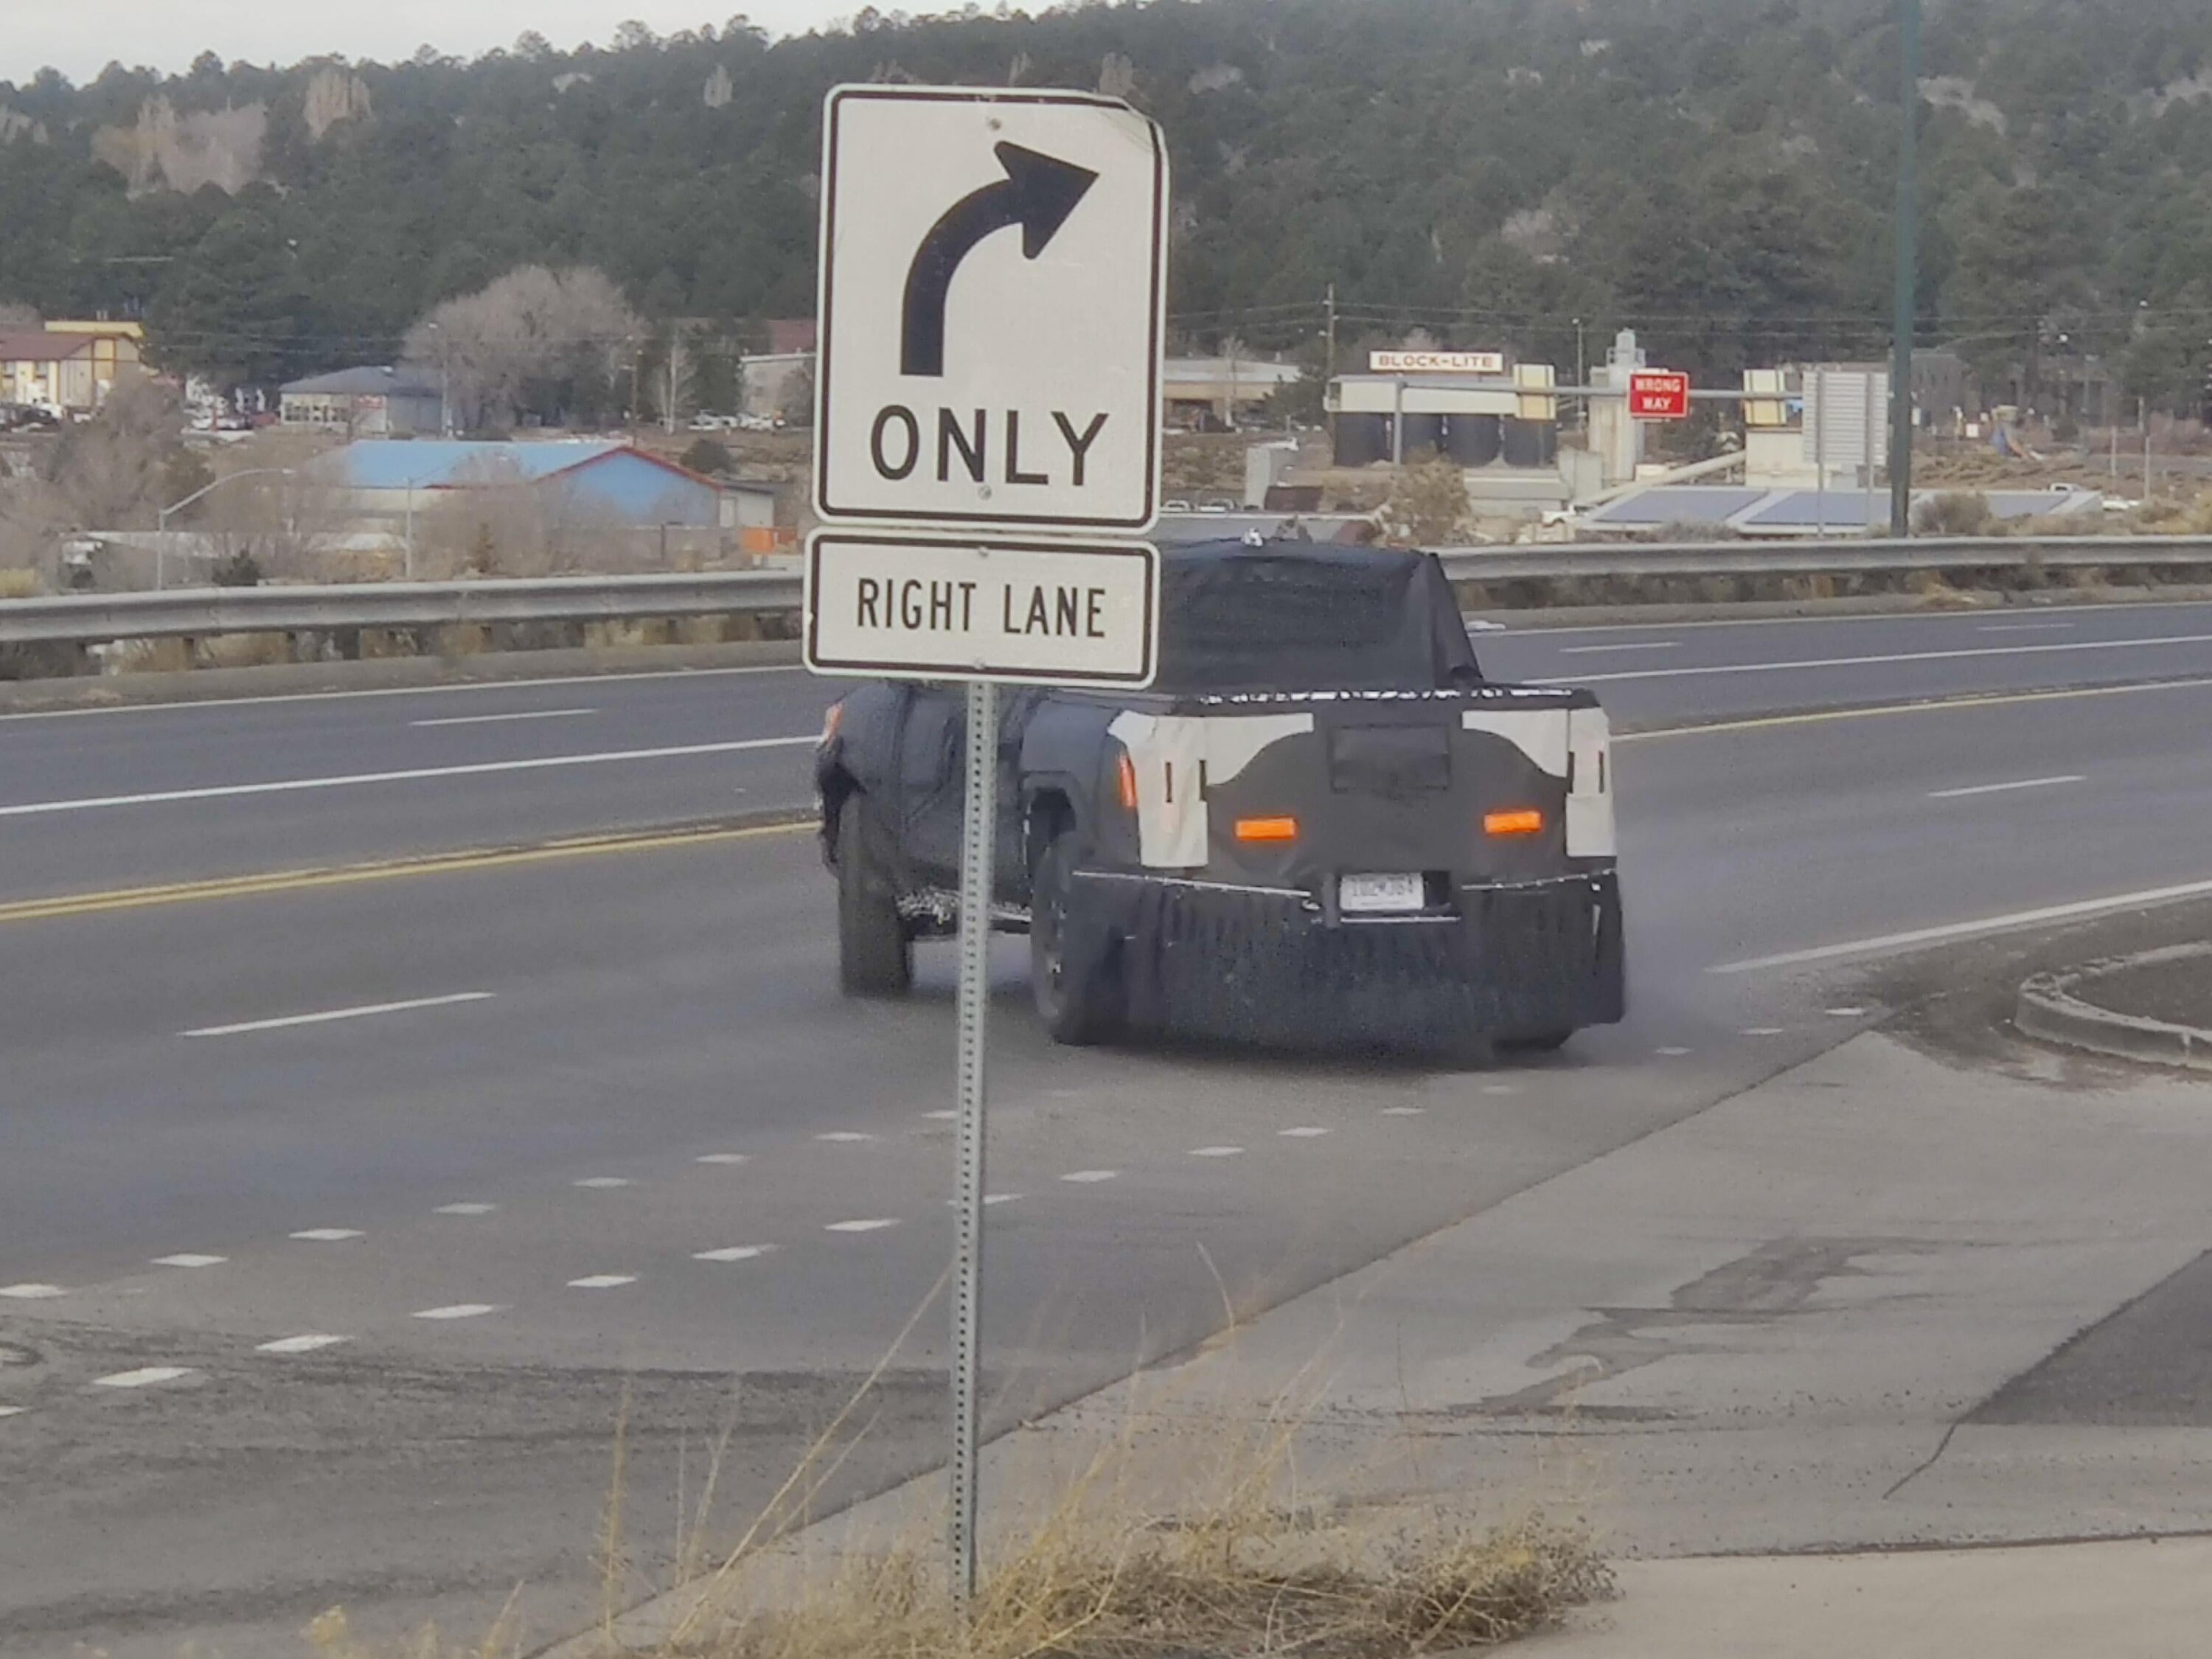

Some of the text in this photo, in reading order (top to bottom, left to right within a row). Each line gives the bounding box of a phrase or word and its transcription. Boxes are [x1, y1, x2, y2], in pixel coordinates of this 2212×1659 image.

[1379, 355, 1494, 367] BLOCK-LITE
[1635, 378, 1681, 392] WRONG
[1643, 397, 1672, 410] WAY
[870, 405, 1109, 486] ONLY
[858, 577, 1106, 638] RIGHT LANE
